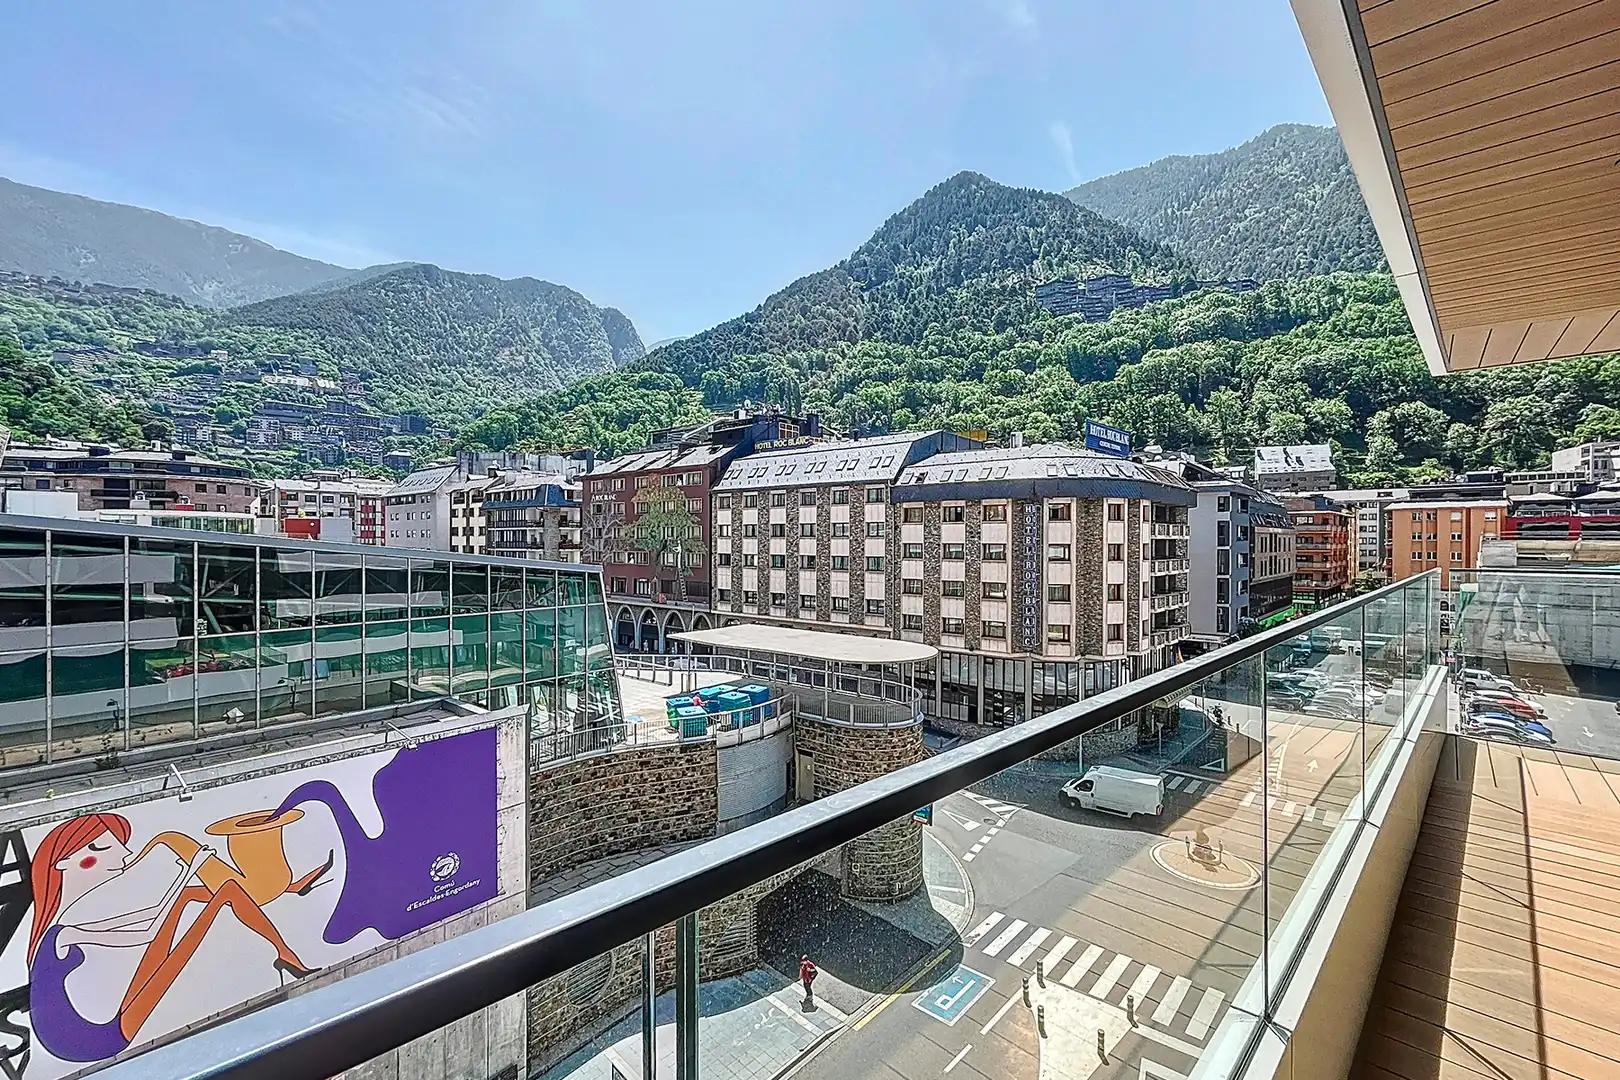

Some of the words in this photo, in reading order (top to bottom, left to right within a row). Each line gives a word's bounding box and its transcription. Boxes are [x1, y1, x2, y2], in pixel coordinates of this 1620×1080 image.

[1090, 424, 1106, 438] HOTEL
[754, 441, 772, 450] HOTEL
[773, 438, 787, 448] ROC
[787, 437, 808, 446] BLANC
[433, 880, 456, 893] Comú
